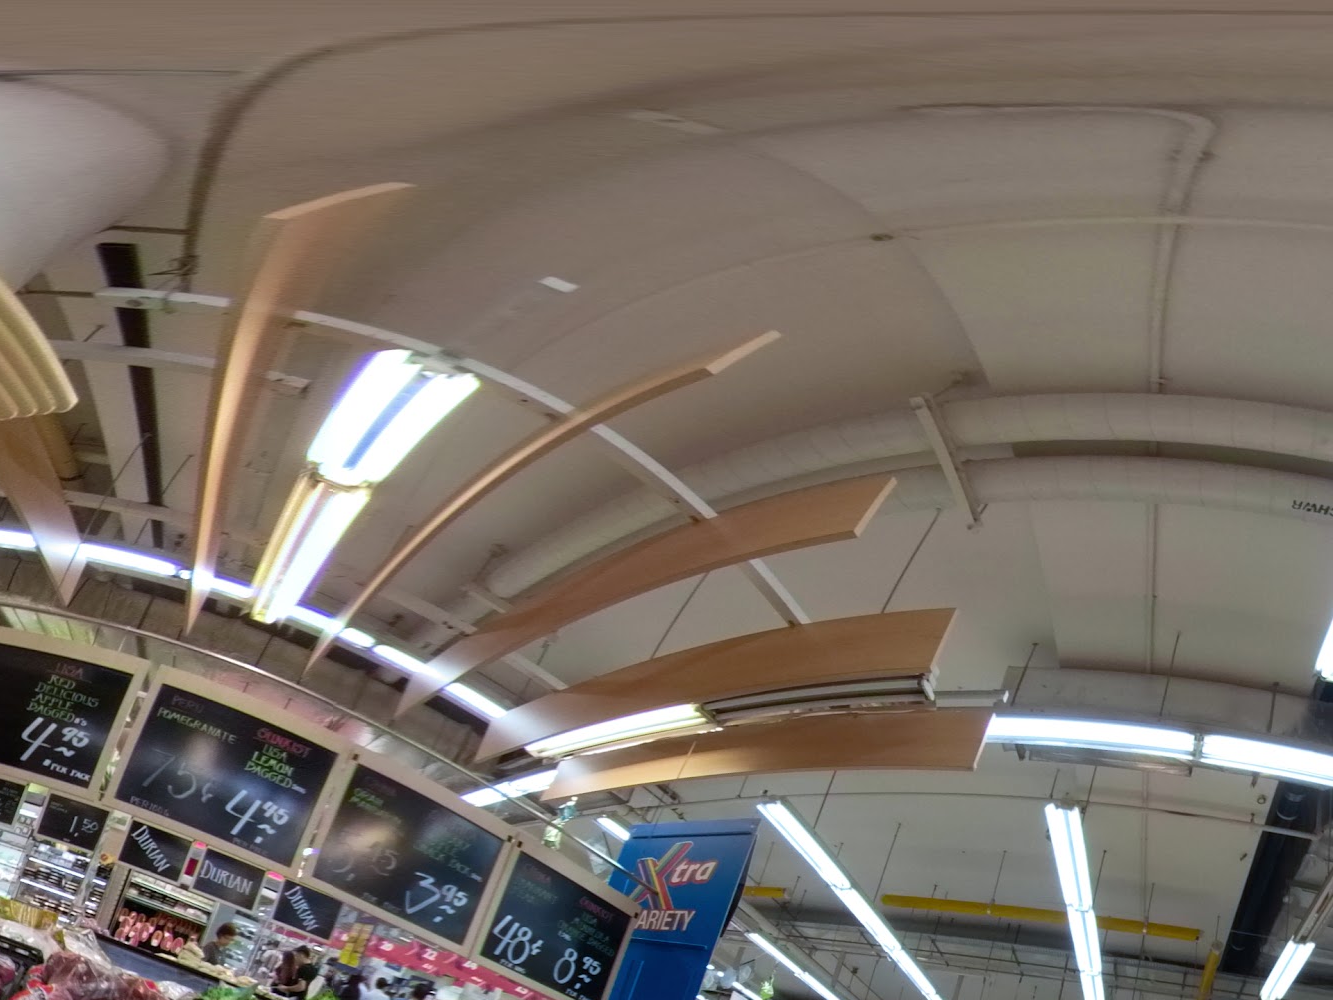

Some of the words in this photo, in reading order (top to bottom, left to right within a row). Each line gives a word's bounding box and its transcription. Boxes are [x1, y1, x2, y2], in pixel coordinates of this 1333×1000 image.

[35, 681, 100, 708] DELICIOUS
[48, 674, 76, 690] RED
[31, 692, 73, 711] APPLE
[157, 706, 238, 745] POMEGRANATE
[251, 750, 296, 776] LEMON
[131, 825, 171, 873] DURIAN
[199, 859, 254, 896] DURIAN
[632, 841, 719, 911] Xtra
[284, 885, 320, 932] DURIAN
[635, 908, 697, 933] ARIETY
